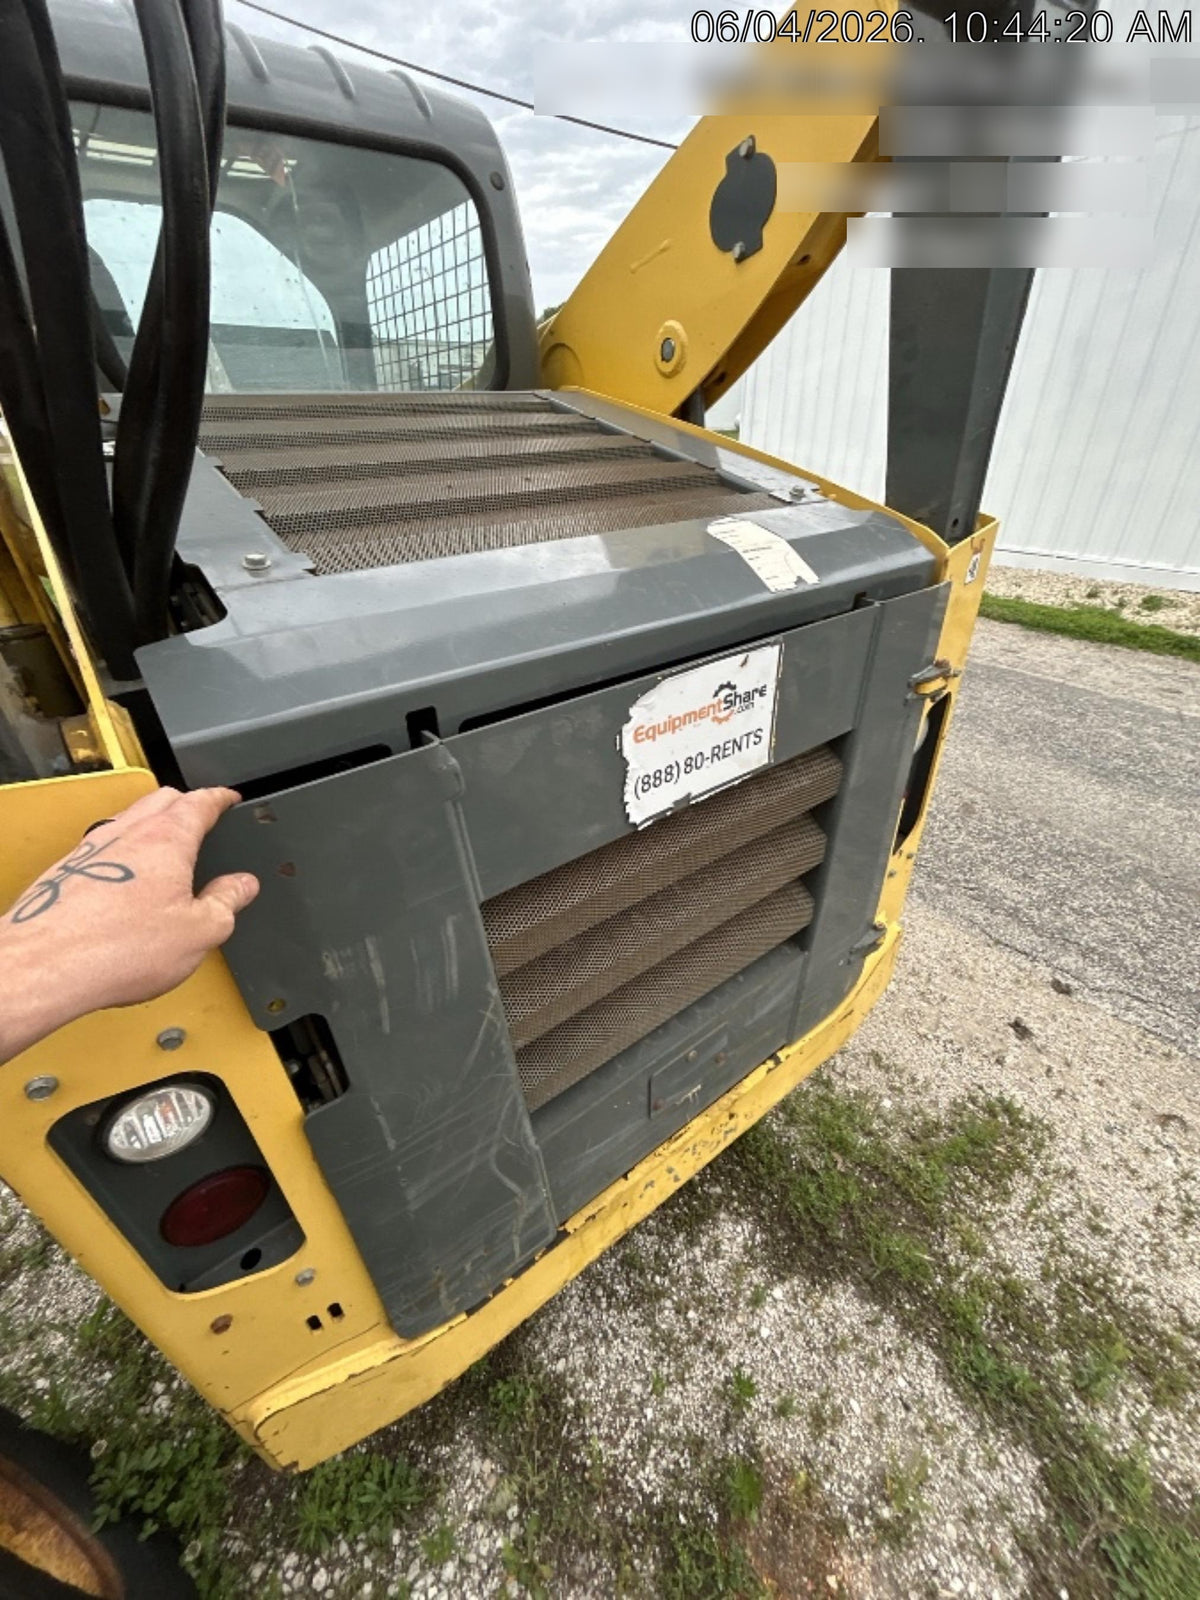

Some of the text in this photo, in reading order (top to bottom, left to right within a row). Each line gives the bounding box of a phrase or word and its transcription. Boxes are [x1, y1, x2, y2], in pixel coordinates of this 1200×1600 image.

[633, 683, 767, 743] EquipmentShare
[634, 728, 763, 800] (888) 80-RENTS
